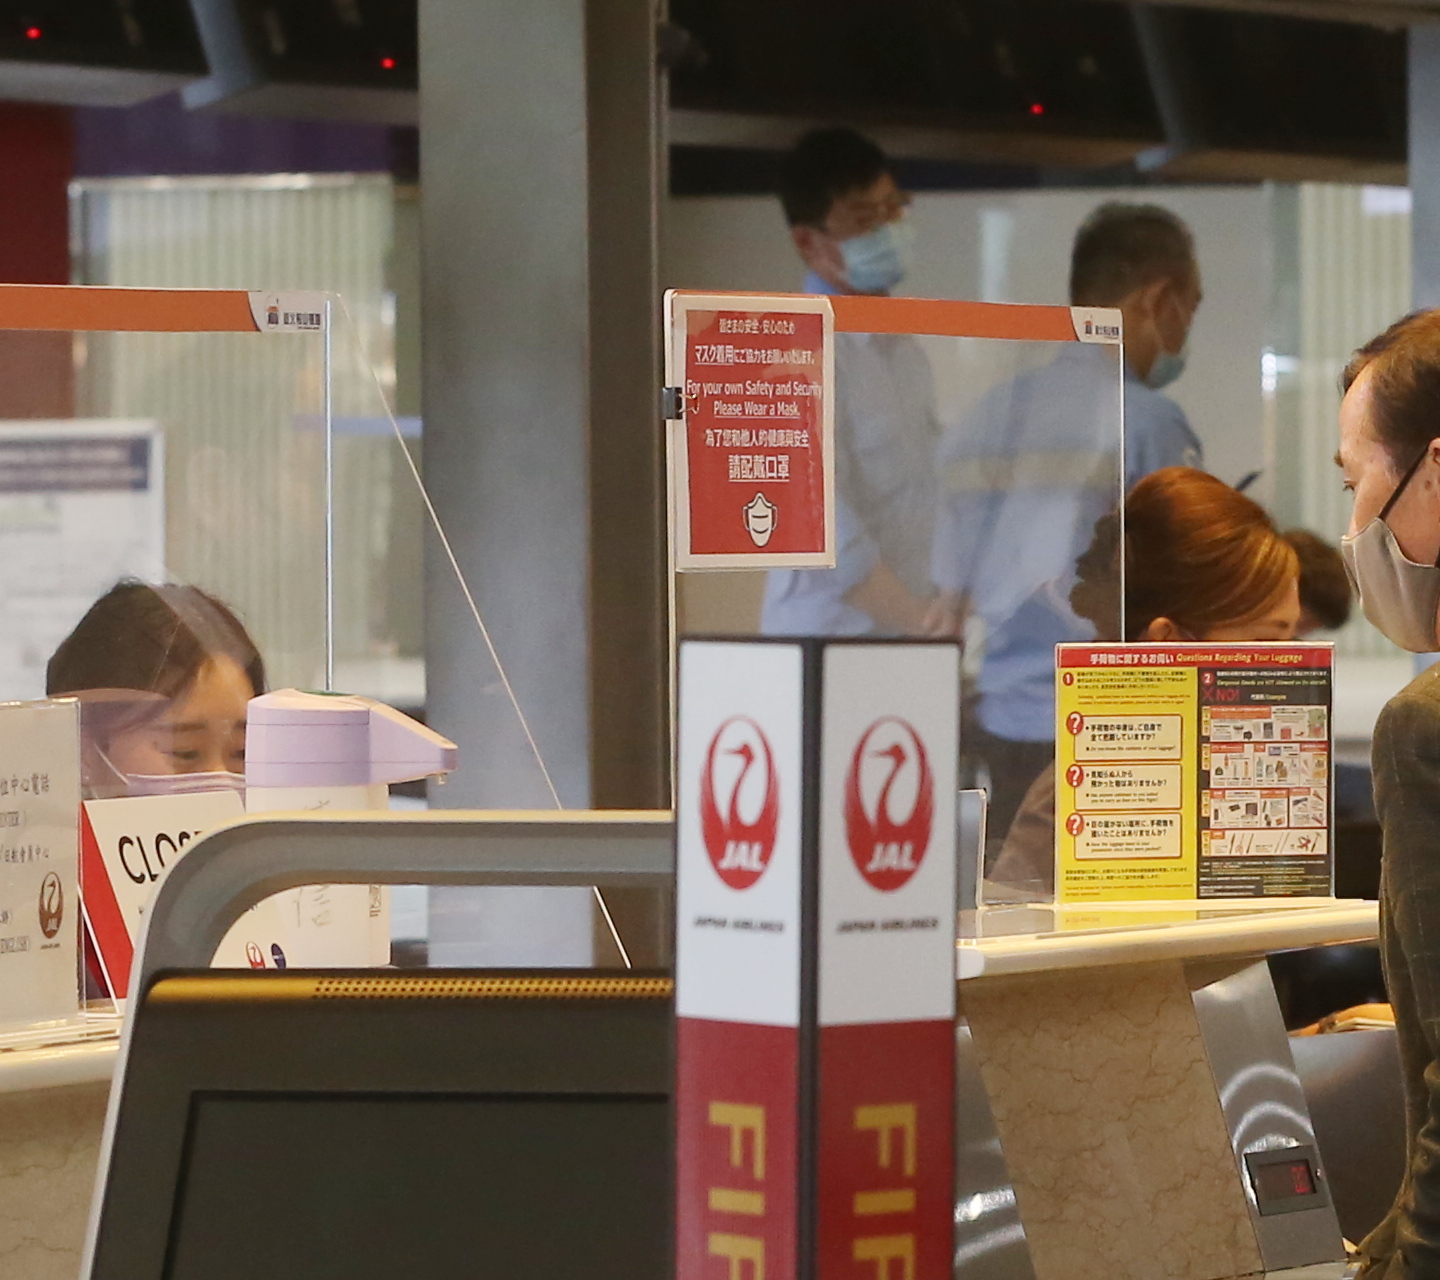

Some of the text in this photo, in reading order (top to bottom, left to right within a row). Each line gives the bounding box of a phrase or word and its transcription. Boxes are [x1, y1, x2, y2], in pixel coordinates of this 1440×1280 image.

[686, 379, 701, 394] For
[702, 382, 722, 398] your
[724, 383, 744, 395] own
[745, 380, 773, 398] Safety
[775, 381, 791, 396] and
[713, 400, 742, 415] Please
[744, 401, 767, 415] Wear
[769, 404, 776, 415] a
[728, 455, 790, 479] 請配戴口罩
[1176, 653, 1213, 663] Questions
[719, 840, 765, 871] JAL
[865, 841, 916, 873] JAL
